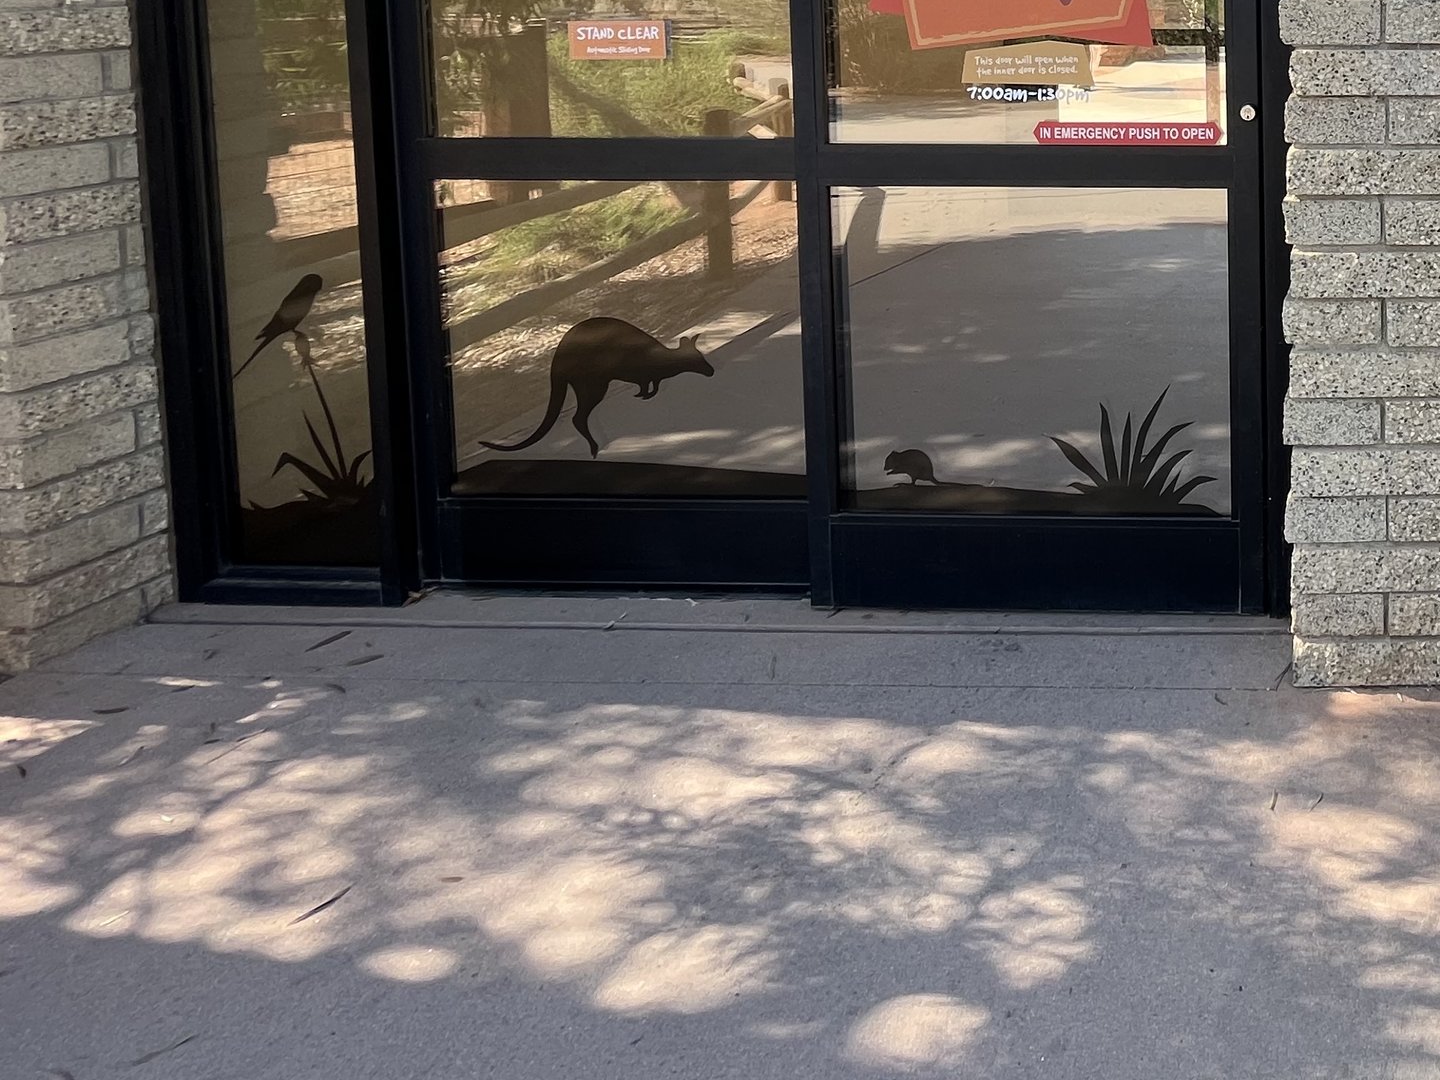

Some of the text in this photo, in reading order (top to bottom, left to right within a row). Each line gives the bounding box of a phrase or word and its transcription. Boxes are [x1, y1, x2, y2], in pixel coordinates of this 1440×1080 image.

[577, 26, 615, 40] STAND
[974, 55, 1079, 68] This door will open when
[976, 67, 992, 79] the
[993, 66, 1015, 75] inner
[1018, 66, 1036, 74] door
[1038, 65, 1047, 75] is
[966, 86, 1089, 105] 7:00am-1:30pm
[1039, 127, 1214, 140] IN EMERGENCY PUSH TO OPEN
